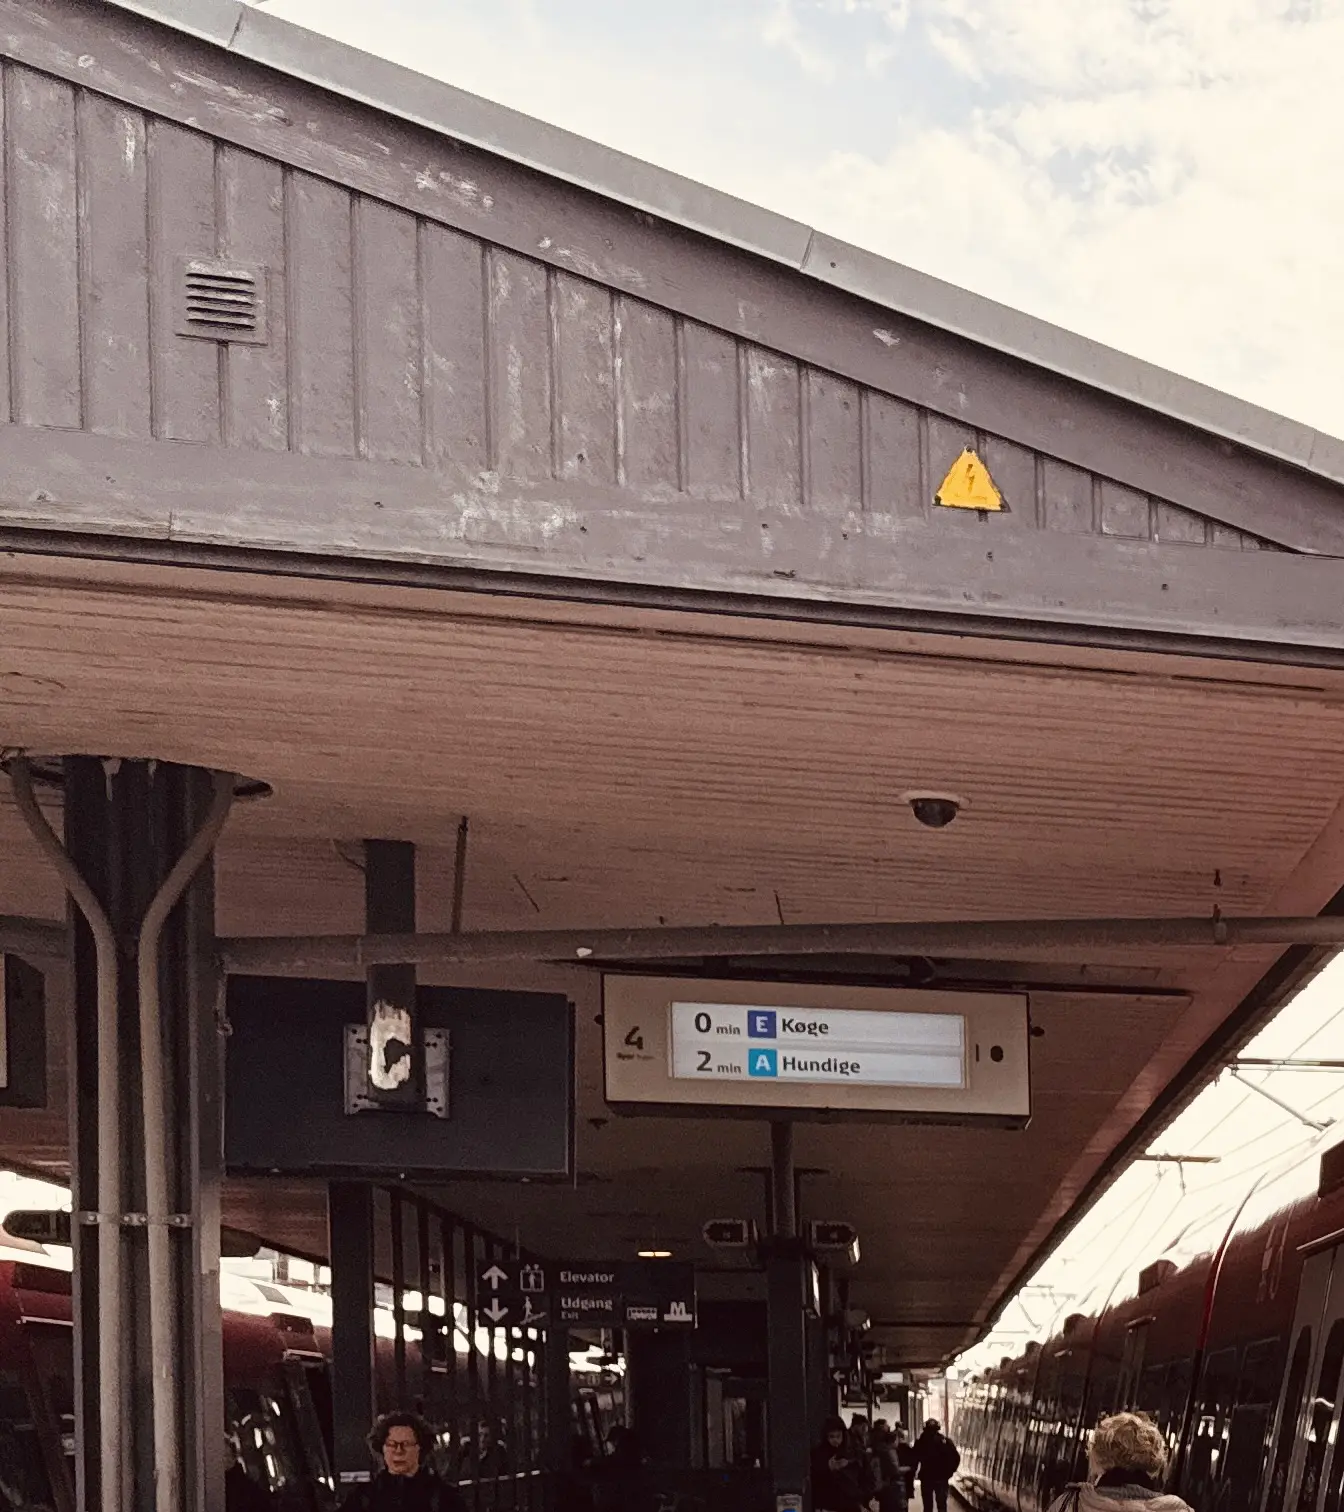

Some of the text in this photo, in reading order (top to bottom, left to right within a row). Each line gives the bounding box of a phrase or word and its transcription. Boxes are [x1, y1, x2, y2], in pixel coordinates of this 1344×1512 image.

[694, 1012, 829, 1037] 0 min E Køge
[624, 1026, 644, 1050] 4
[696, 1050, 861, 1076] 2 min A Hundige
[560, 1271, 614, 1284] Elevator
[561, 1297, 613, 1311] Udgang
